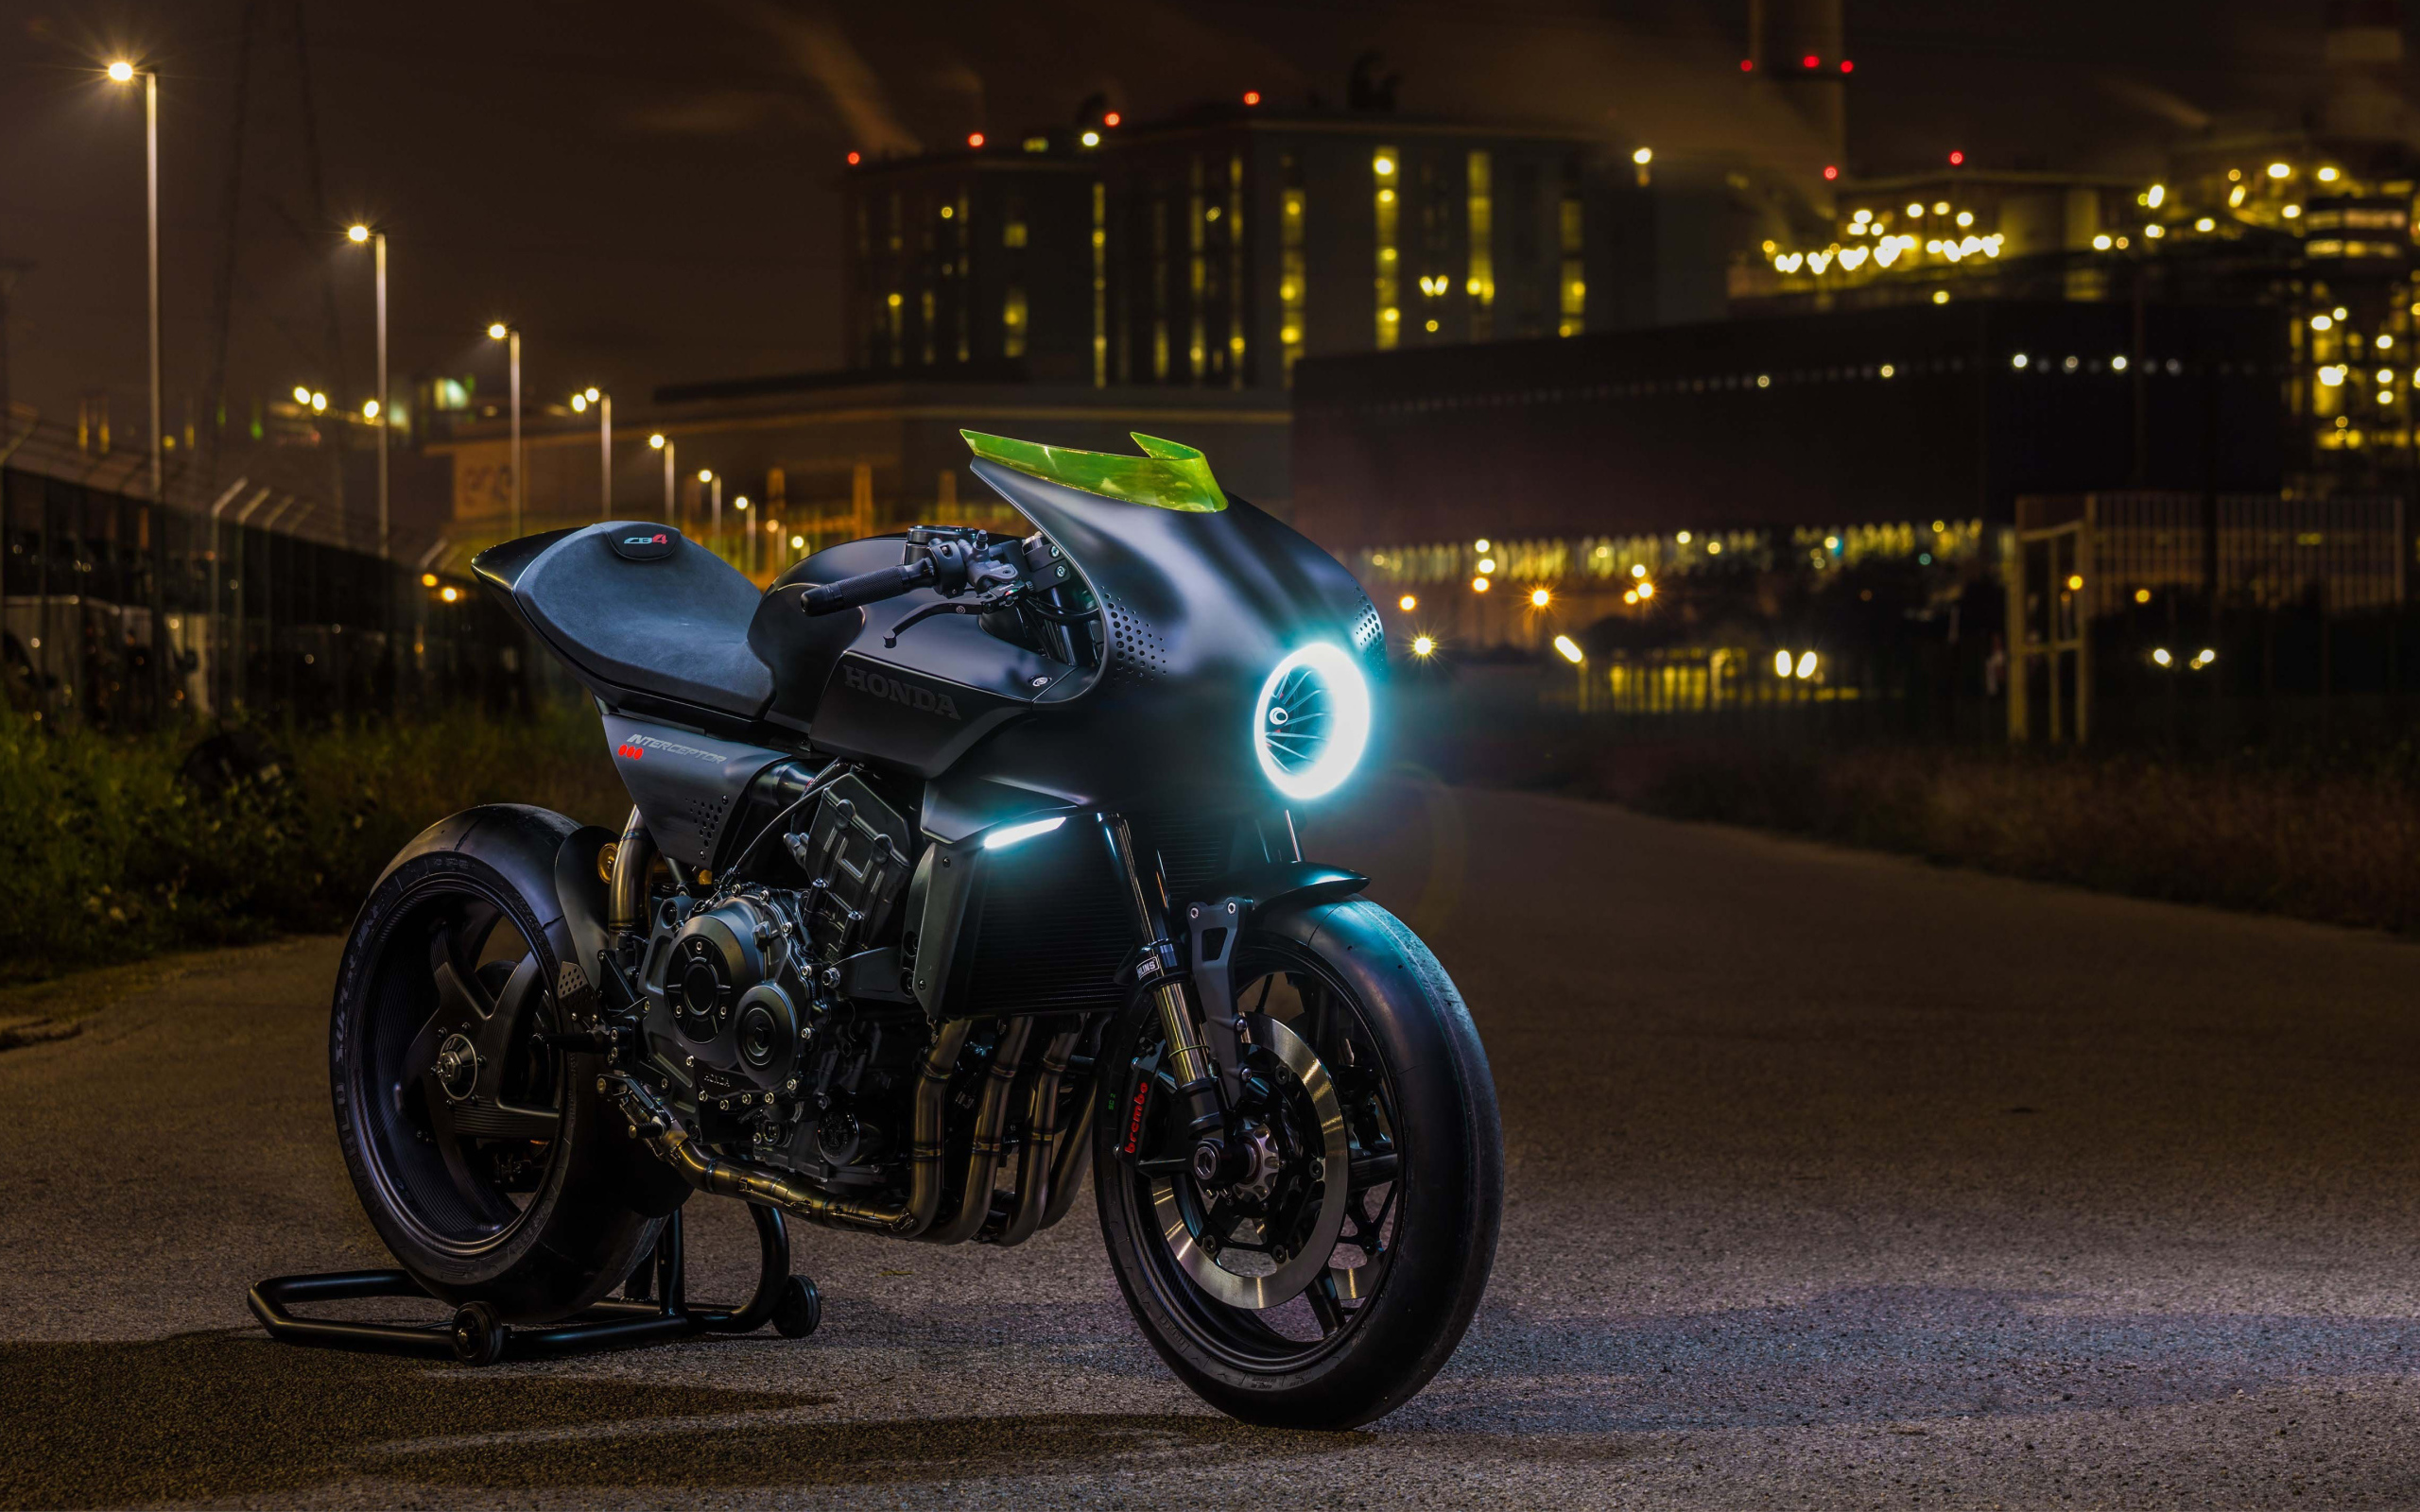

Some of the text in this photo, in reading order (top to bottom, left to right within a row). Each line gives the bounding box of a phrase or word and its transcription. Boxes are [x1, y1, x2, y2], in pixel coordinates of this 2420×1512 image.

[624, 534, 667, 544] CB4
[842, 664, 961, 720] HONDA
[627, 734, 728, 764] INTERCEPTOR
[1124, 1082, 1149, 1154] brembo
